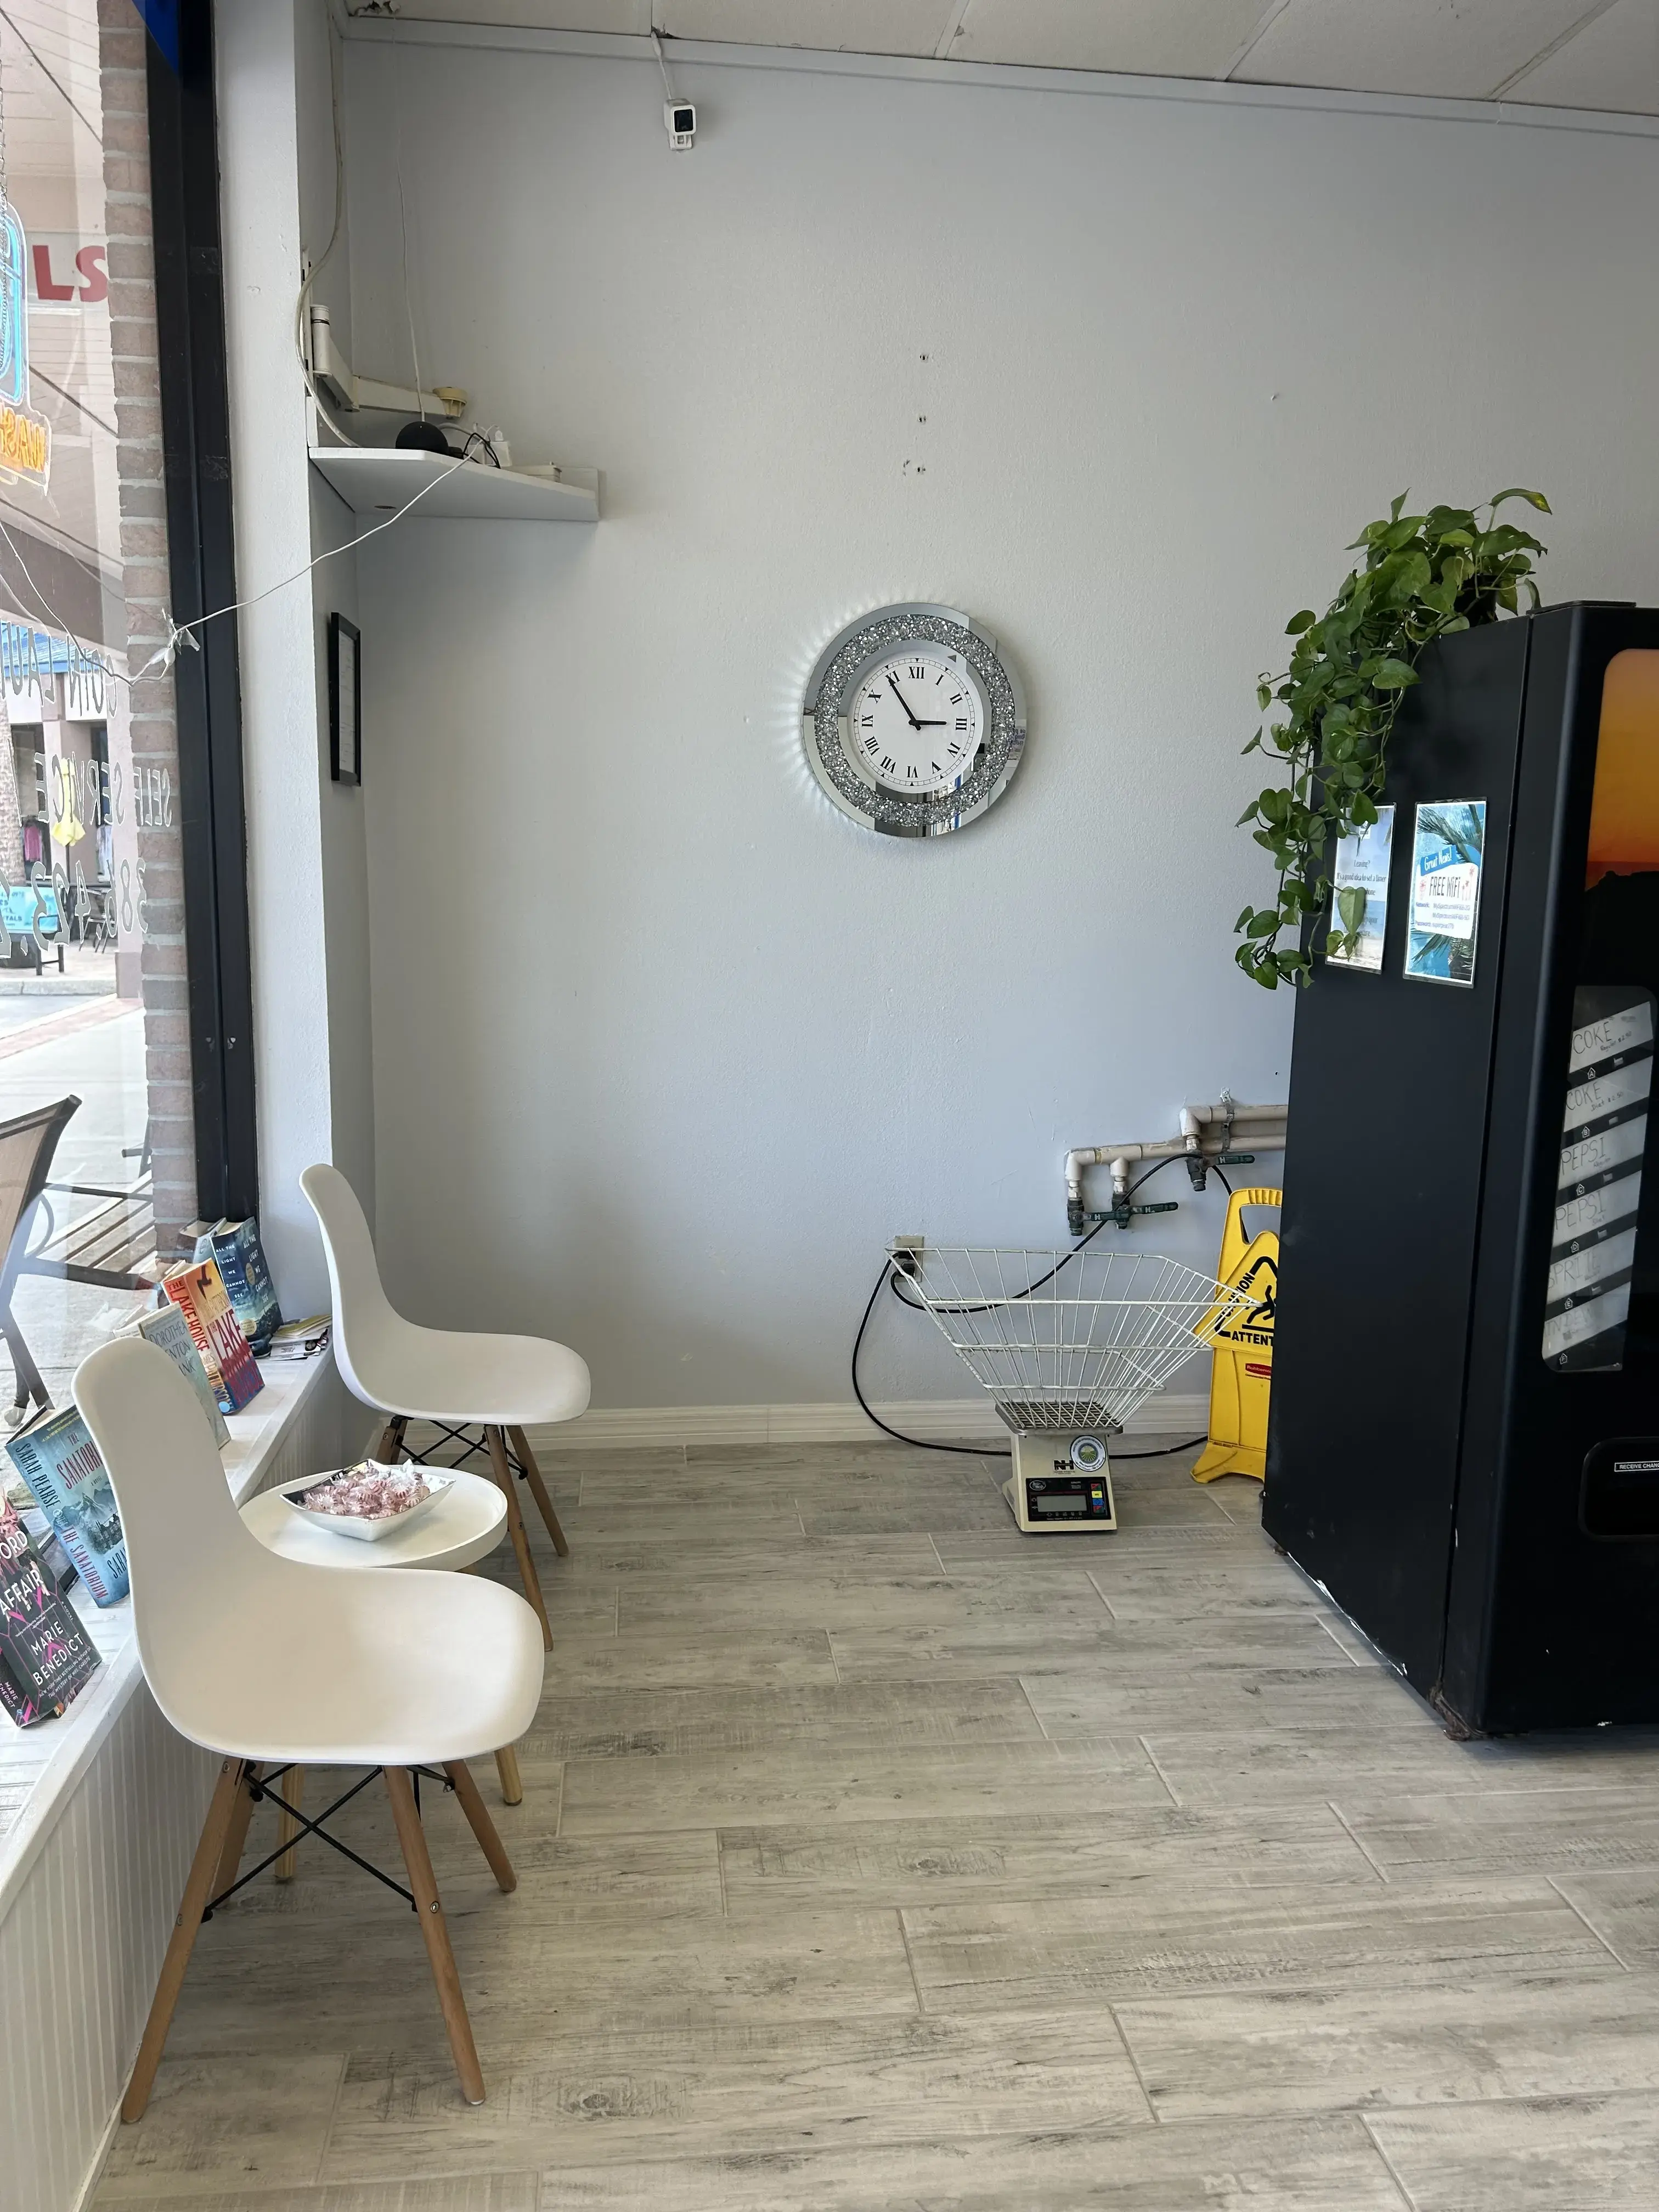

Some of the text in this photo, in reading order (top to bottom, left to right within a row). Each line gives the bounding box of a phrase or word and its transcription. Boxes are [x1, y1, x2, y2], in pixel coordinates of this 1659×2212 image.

[908, 667, 925, 679] XII
[935, 674, 944, 686] I
[867, 689, 882, 704] X
[950, 692, 963, 705] II
[861, 715, 873, 727] IX
[955, 718, 968, 731] III
[864, 736, 881, 756] VIII
[947, 742, 961, 758] IV
[880, 755, 896, 774] VII
[906, 766, 918, 778] VI
[932, 761, 942, 774] V
[1354, 859, 1370, 869] Leaving?
[1424, 846, 1452, 871] Great News!
[1345, 873, 1354, 882] good
[1429, 876, 1446, 896] FREE
[1573, 1021, 1612, 1054] COKE
[1566, 1081, 1602, 1110] COKE
[1561, 1137, 1606, 1176] PEPSI
[1555, 1189, 1606, 1231] PEPSI
[249, 1249, 259, 1262] LIGHT
[255, 1265, 261, 1274] WE
[225, 1279, 245, 1288] CANNOT
[255, 1276, 268, 1293] CANNOT
[168, 1279, 184, 1290] THE
[187, 1318, 211, 1352] HOUSE
[149, 1321, 188, 1347] DOROTHEA
[206, 1309, 251, 1361] LAKE
[67, 1431, 80, 1446] THE
[57, 1441, 104, 1489] SANATORI
[16, 1442, 43, 1475] SARAH
[32, 1473, 61, 1509] PEARSE
[0, 1530, 28, 1559] ORD
[60, 1524, 80, 1545] THE
[70, 1543, 109, 1600] SANATORIUM
[107, 1547, 127, 1579] SARA
[0, 1568, 44, 1616] AFFAIR
[31, 1621, 64, 1656] MARIE
[32, 1633, 83, 1686] BENEDICT
[4, 1681, 19, 1700] MARIE
